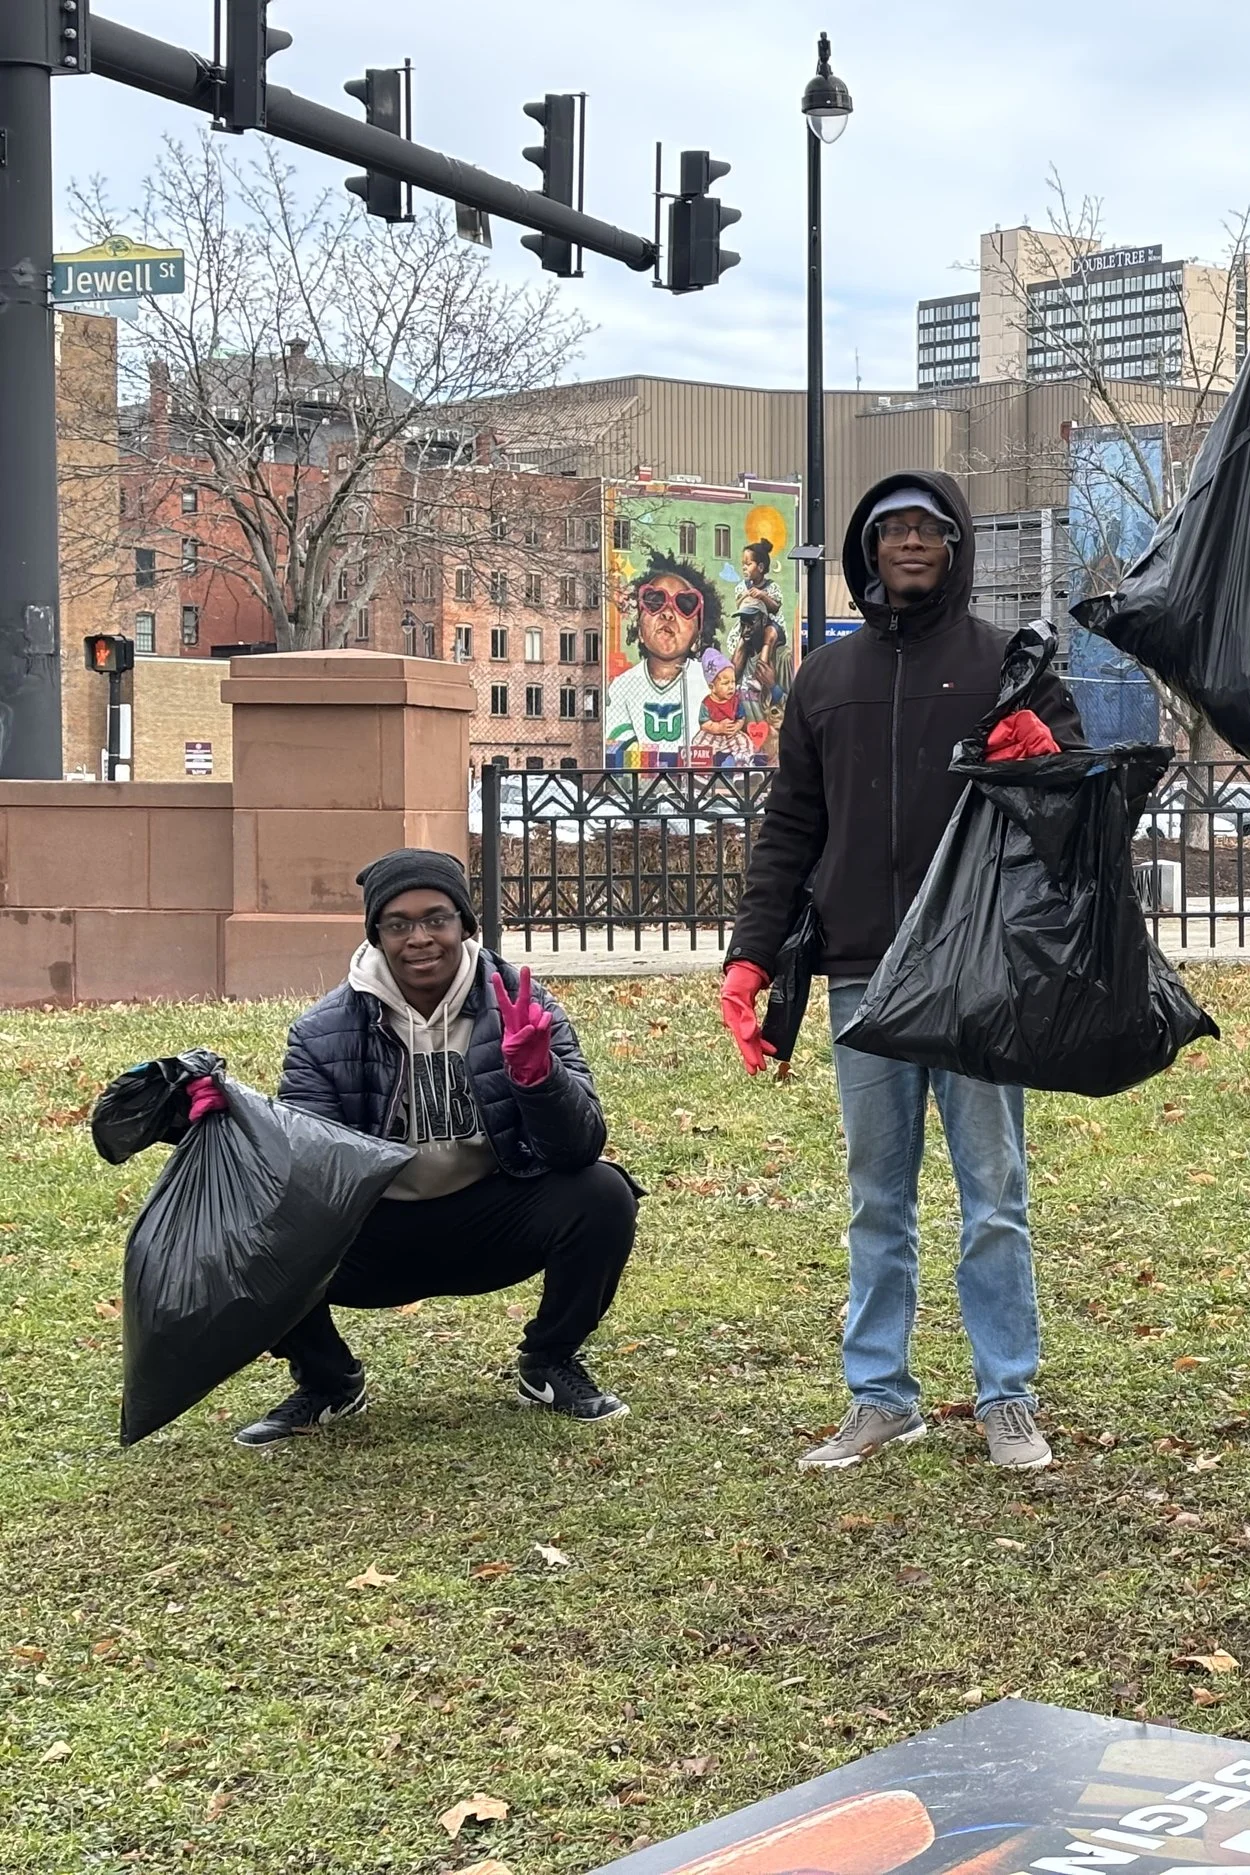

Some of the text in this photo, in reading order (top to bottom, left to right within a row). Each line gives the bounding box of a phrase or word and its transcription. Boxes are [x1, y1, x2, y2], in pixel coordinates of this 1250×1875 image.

[62, 262, 176, 294] Jewell St
[693, 749, 710, 759] PARK
[412, 1049, 485, 1142] NB
